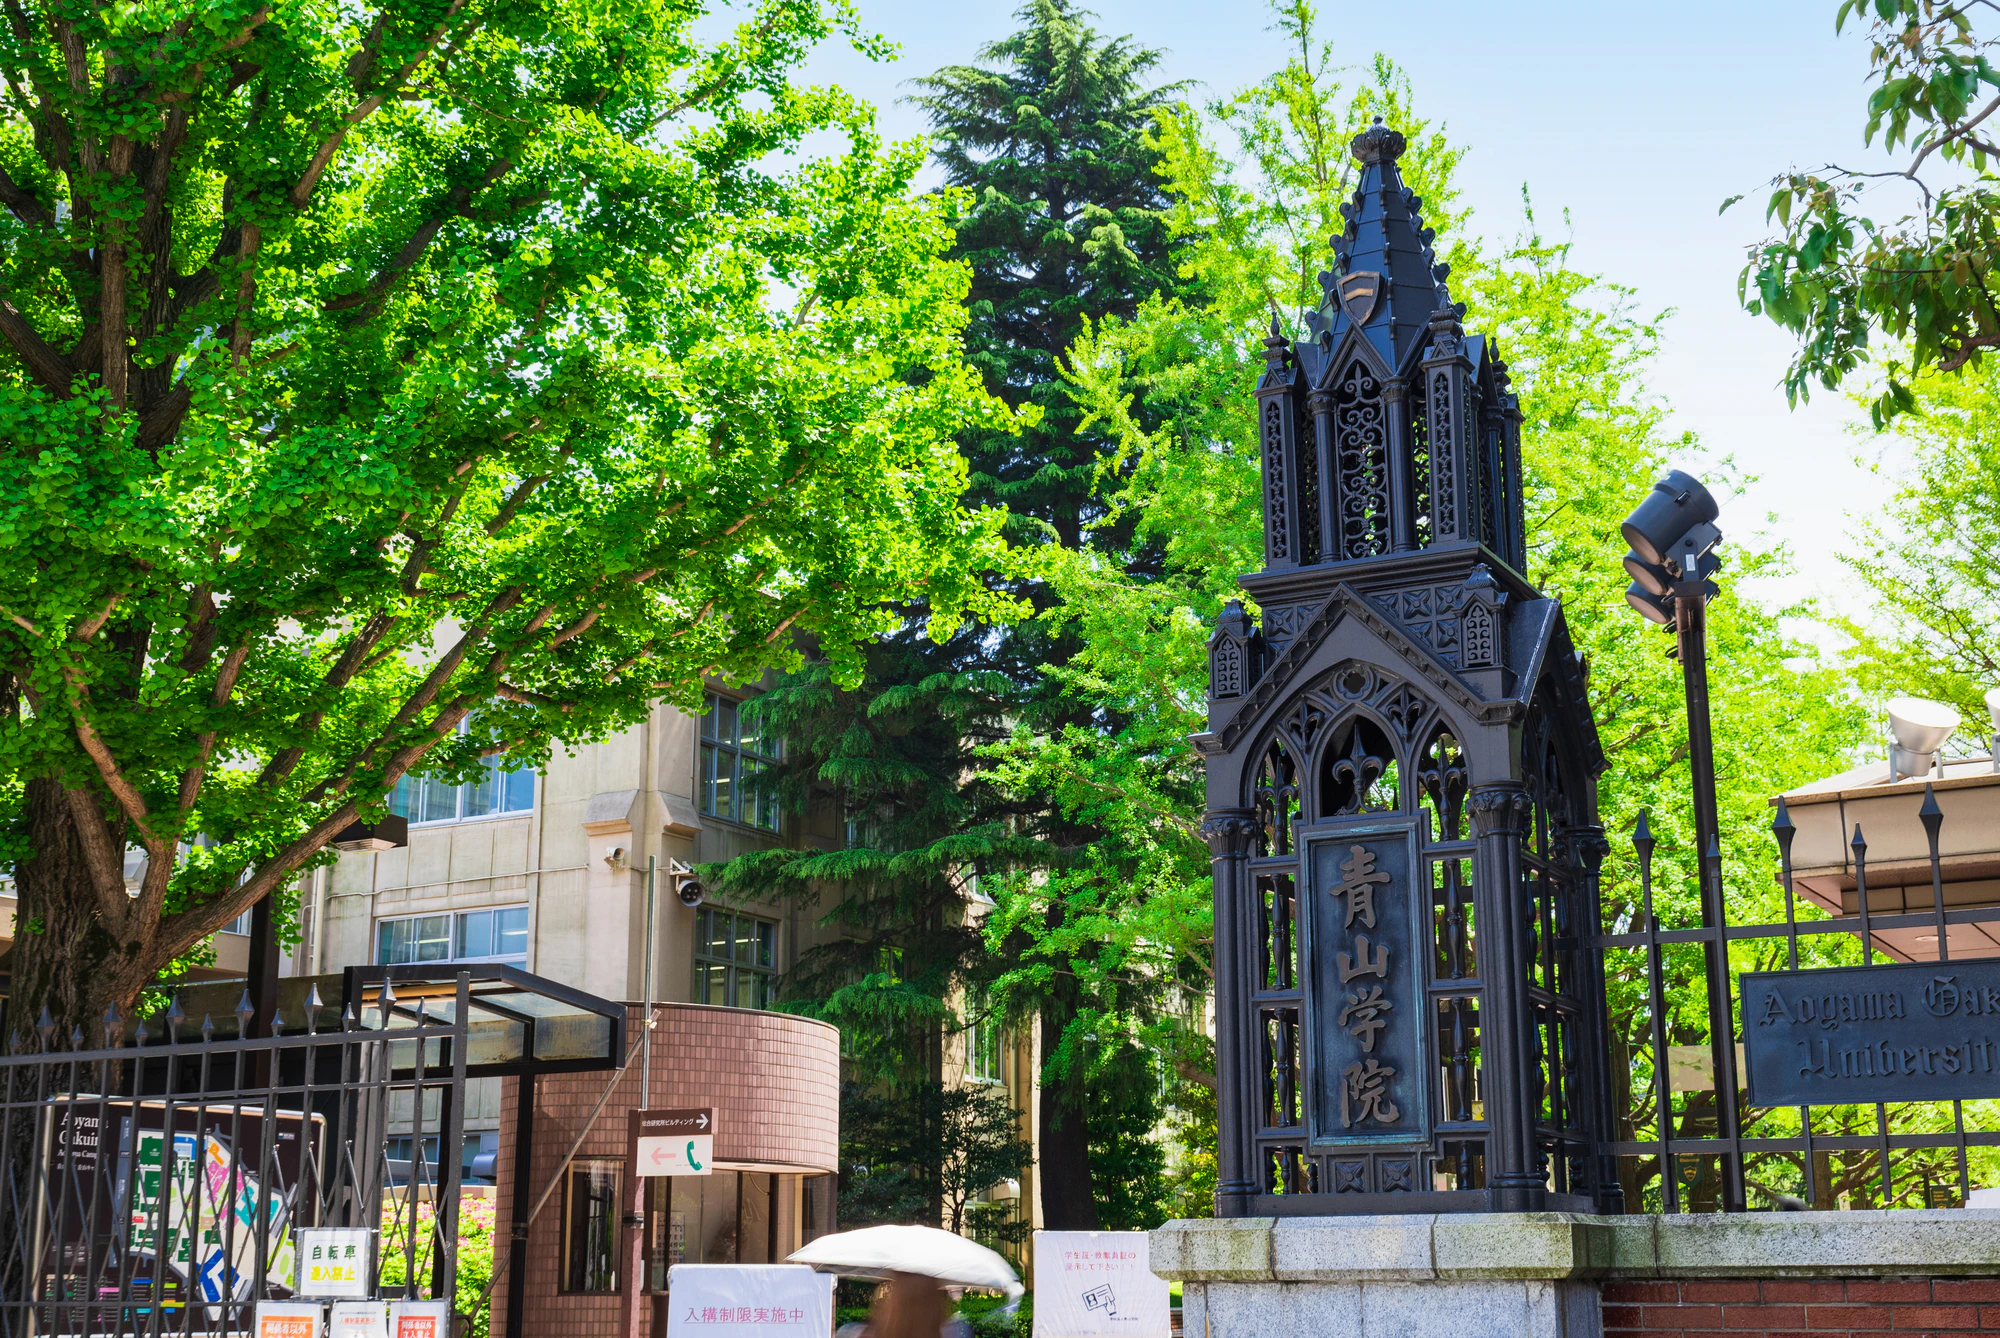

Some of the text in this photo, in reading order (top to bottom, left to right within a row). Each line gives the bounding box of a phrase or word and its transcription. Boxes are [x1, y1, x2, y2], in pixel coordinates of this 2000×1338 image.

[1329, 845, 1399, 1128] 青山学院
[1758, 985, 1905, 1030] Aoyama
[1797, 1035, 2000, 1079] Universit
[60, 1111, 109, 1130] Ayam
[312, 1244, 356, 1260] 自転車
[685, 1306, 804, 1323] 入構制限実施中
